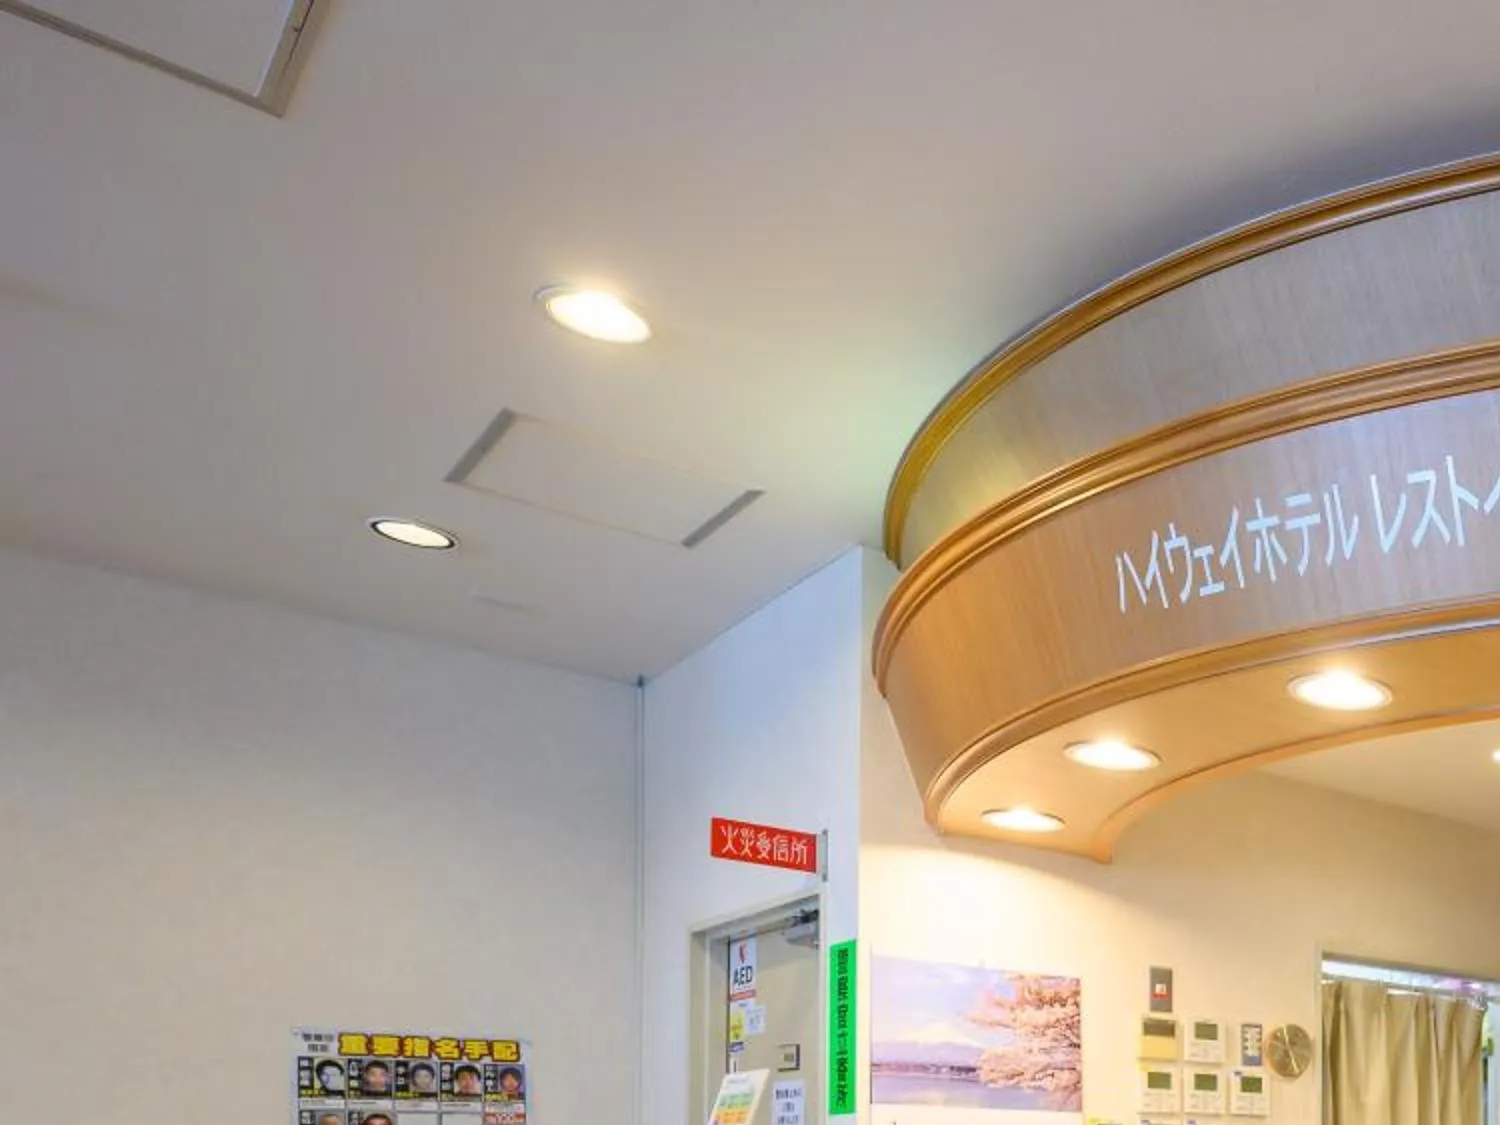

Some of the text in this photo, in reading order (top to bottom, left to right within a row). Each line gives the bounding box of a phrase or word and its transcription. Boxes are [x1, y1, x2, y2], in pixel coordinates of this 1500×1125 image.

[1115, 484, 1360, 612] ハイウェイホテル
[720, 822, 808, 866] 火災受信所
[733, 966, 754, 988] AED
